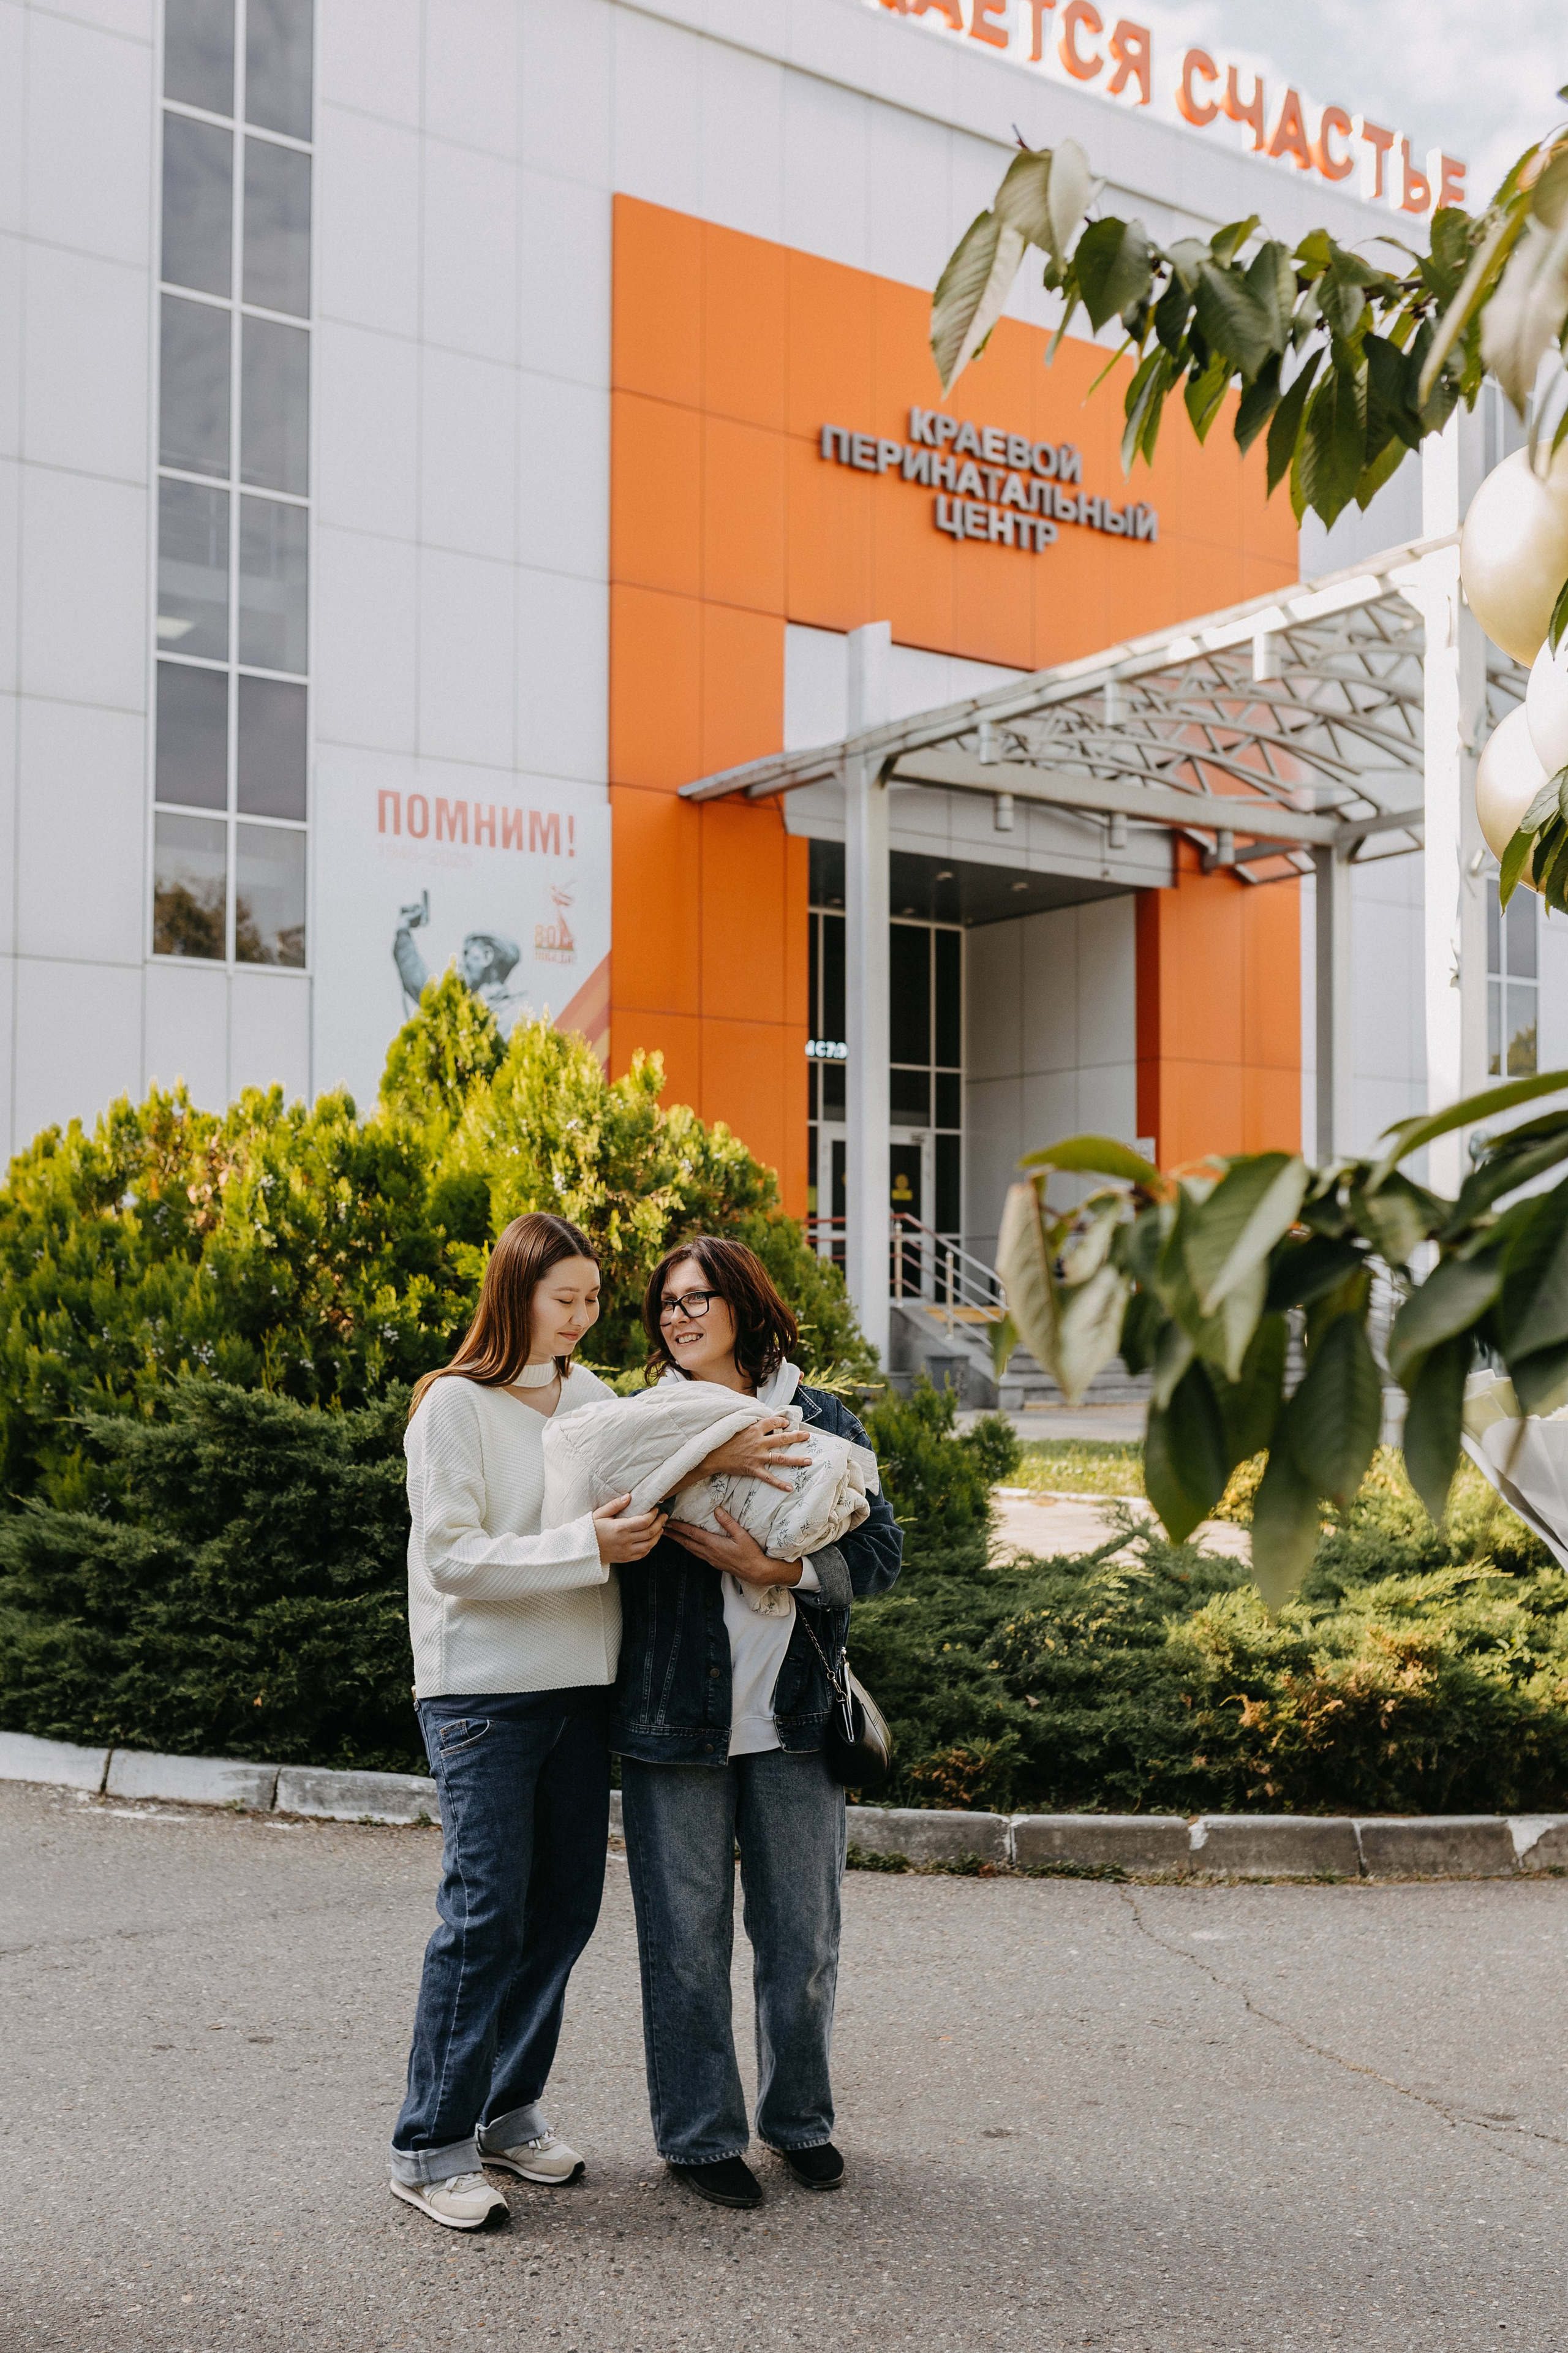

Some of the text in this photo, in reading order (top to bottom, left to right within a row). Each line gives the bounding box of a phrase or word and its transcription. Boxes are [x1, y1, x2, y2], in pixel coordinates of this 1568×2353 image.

[1174, 48, 1466, 214] СЧАСТЬЕ
[820, 423, 1159, 542] ПЕРИНАТАЛЬНЫЙ
[909, 405, 1082, 485] КРАЕВОЙ
[935, 493, 1059, 553] ЦЕНТР
[377, 788, 575, 858] ПОМНИМ!
